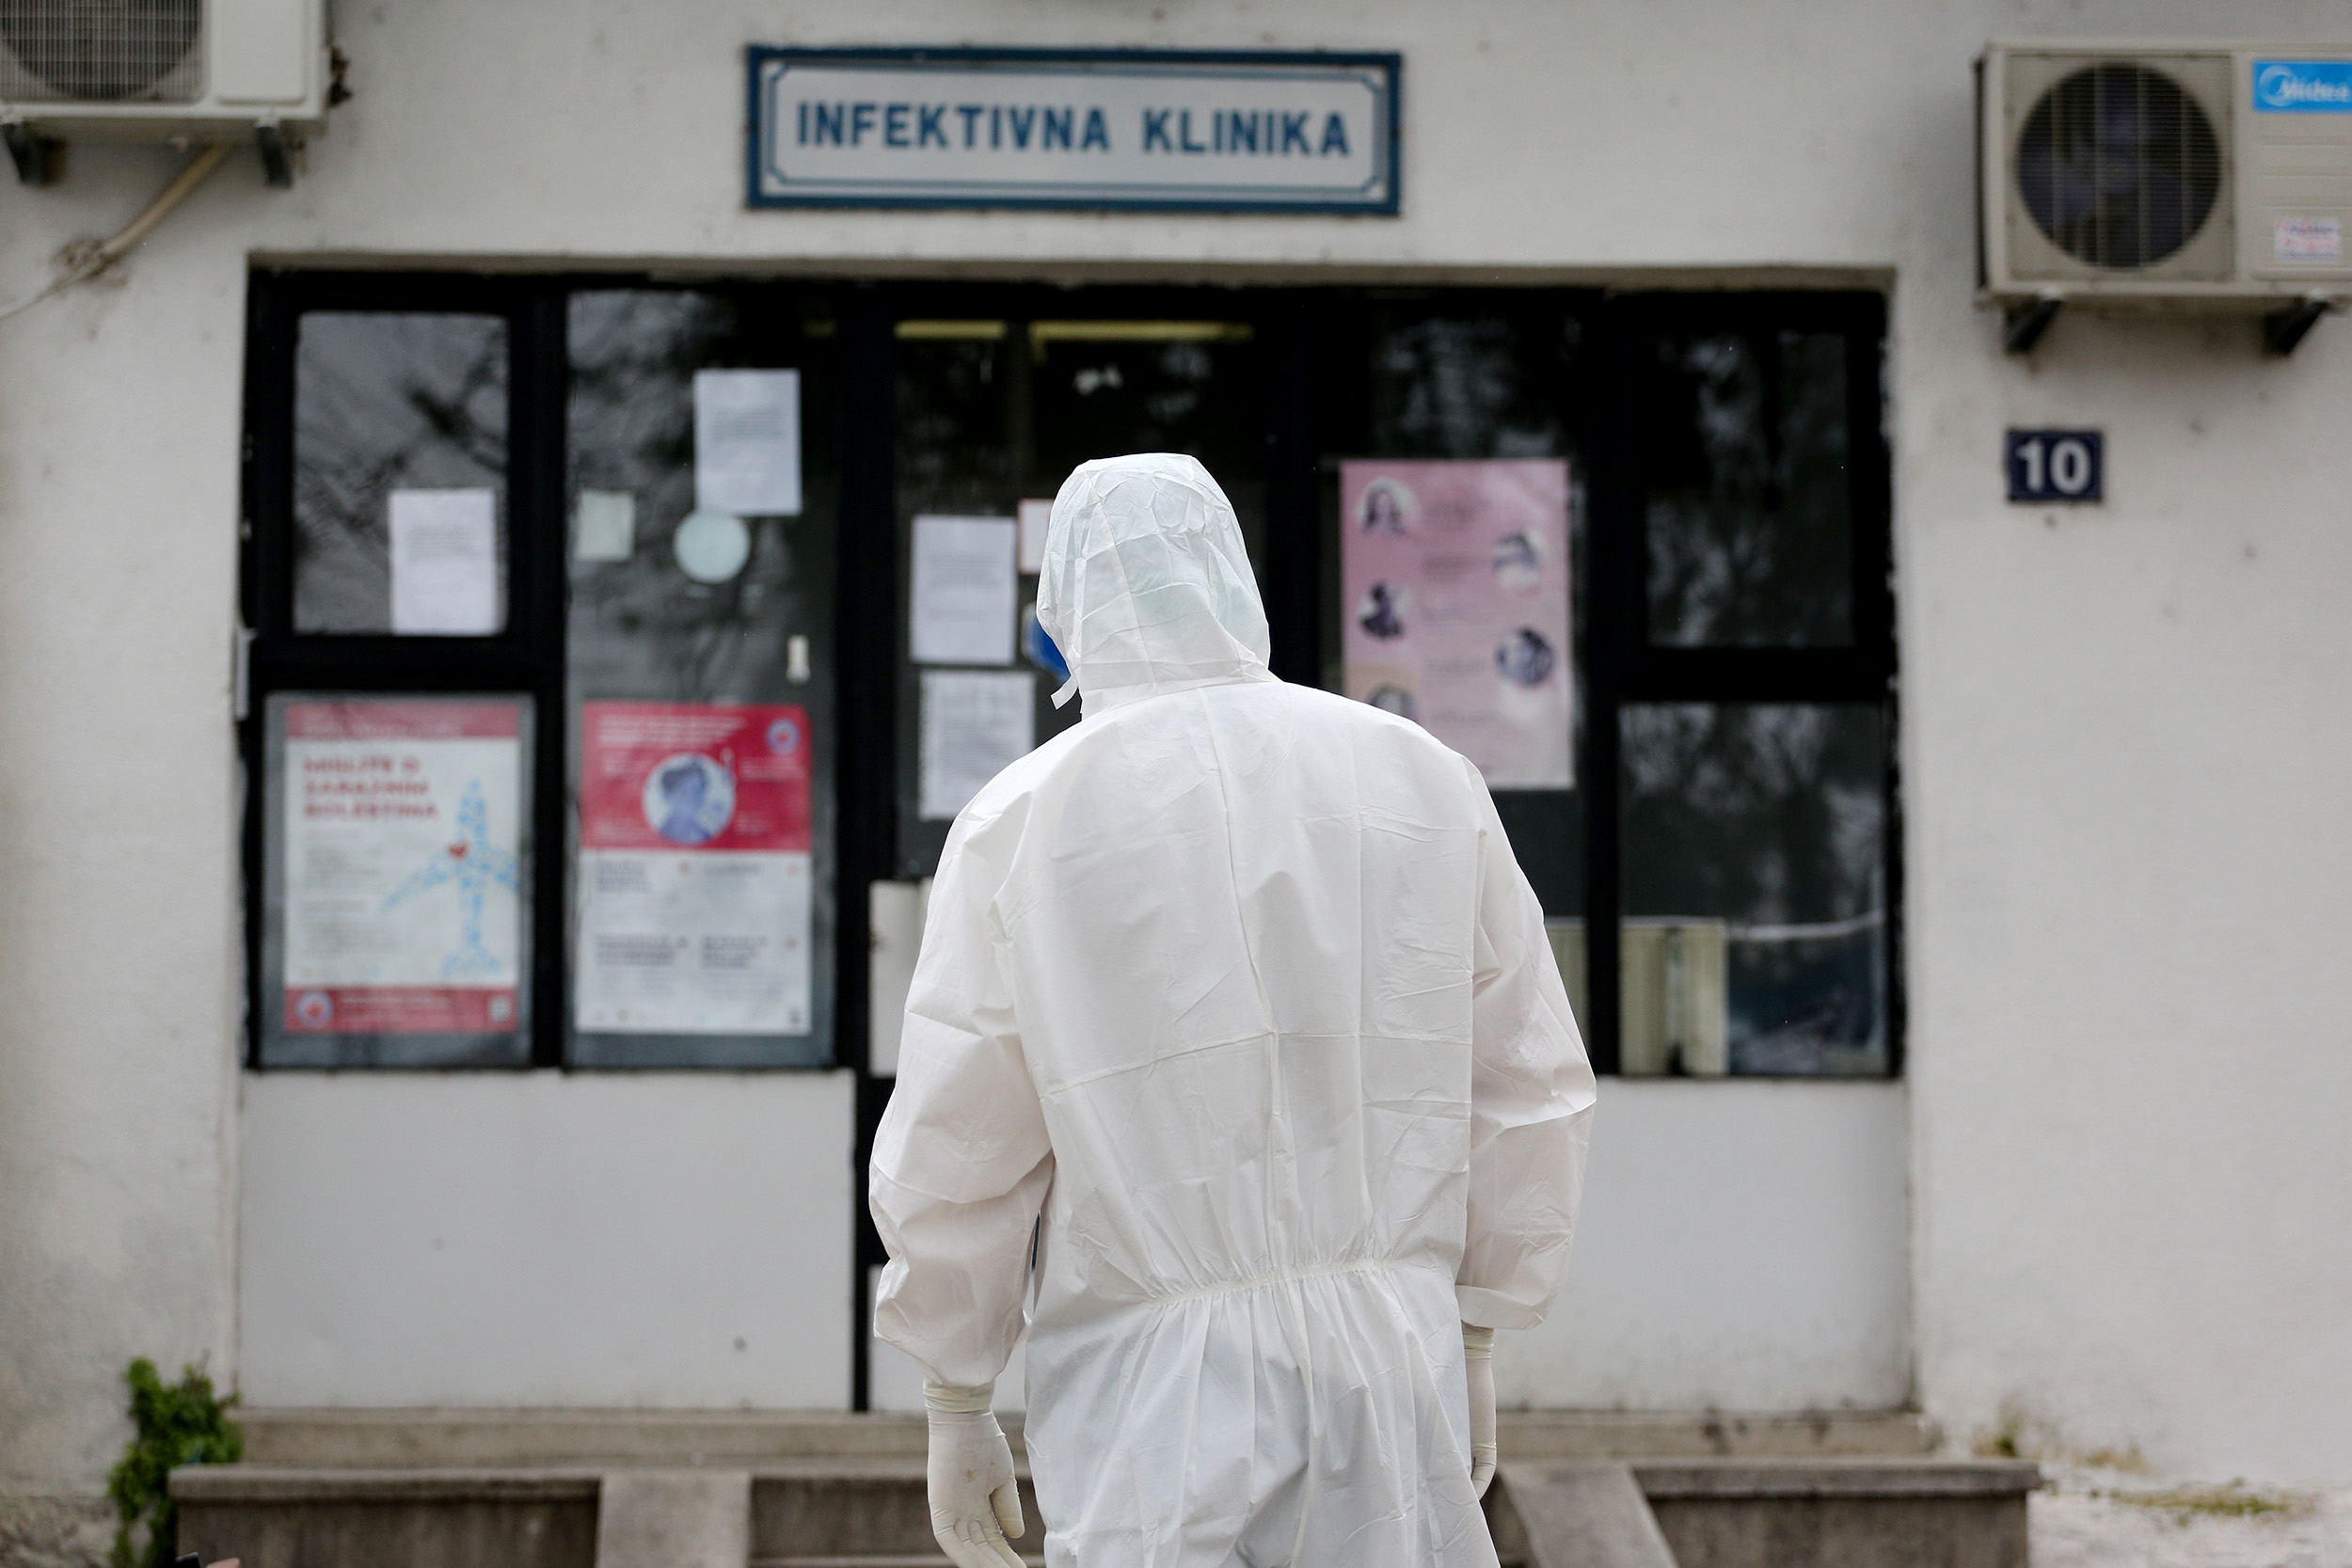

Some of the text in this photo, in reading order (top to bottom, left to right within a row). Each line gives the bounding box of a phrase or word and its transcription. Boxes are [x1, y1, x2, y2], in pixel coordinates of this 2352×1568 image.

[797, 101, 1351, 156] INFEKTIVNA KLINIKA
[2015, 438, 2091, 496] 10
